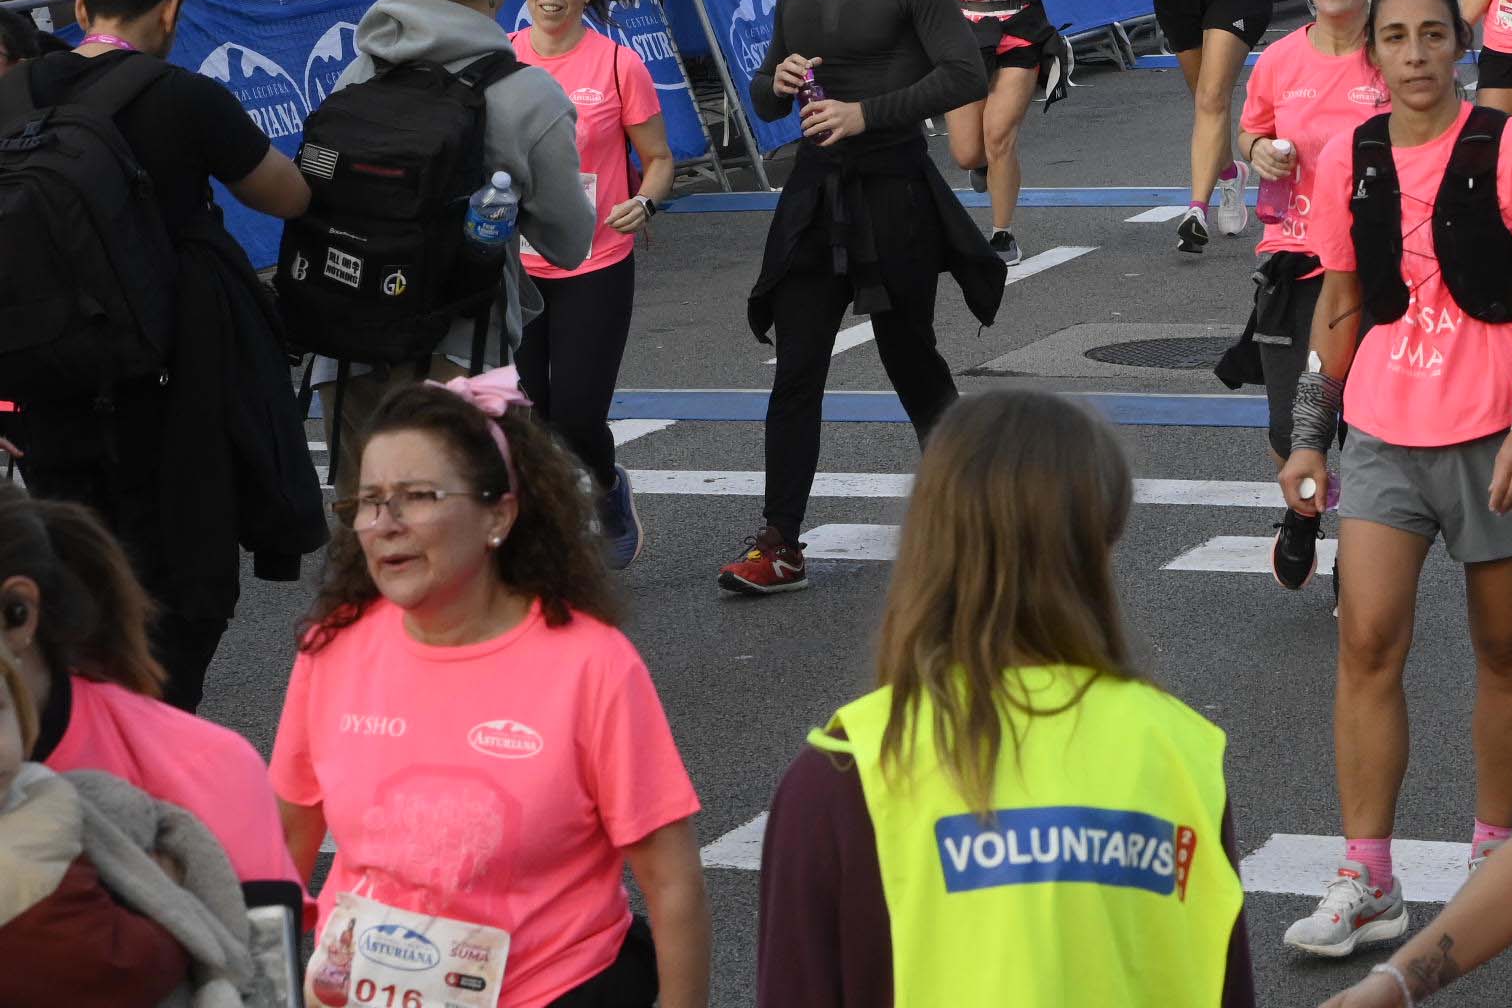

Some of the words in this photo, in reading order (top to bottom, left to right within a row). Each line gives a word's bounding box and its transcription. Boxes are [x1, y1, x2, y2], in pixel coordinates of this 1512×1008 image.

[472, 729, 538, 752] ASTURIANA
[944, 825, 1175, 877] VOLUNTARIS
[365, 936, 434, 966] ASTURIANA
[449, 943, 491, 963] SUMA
